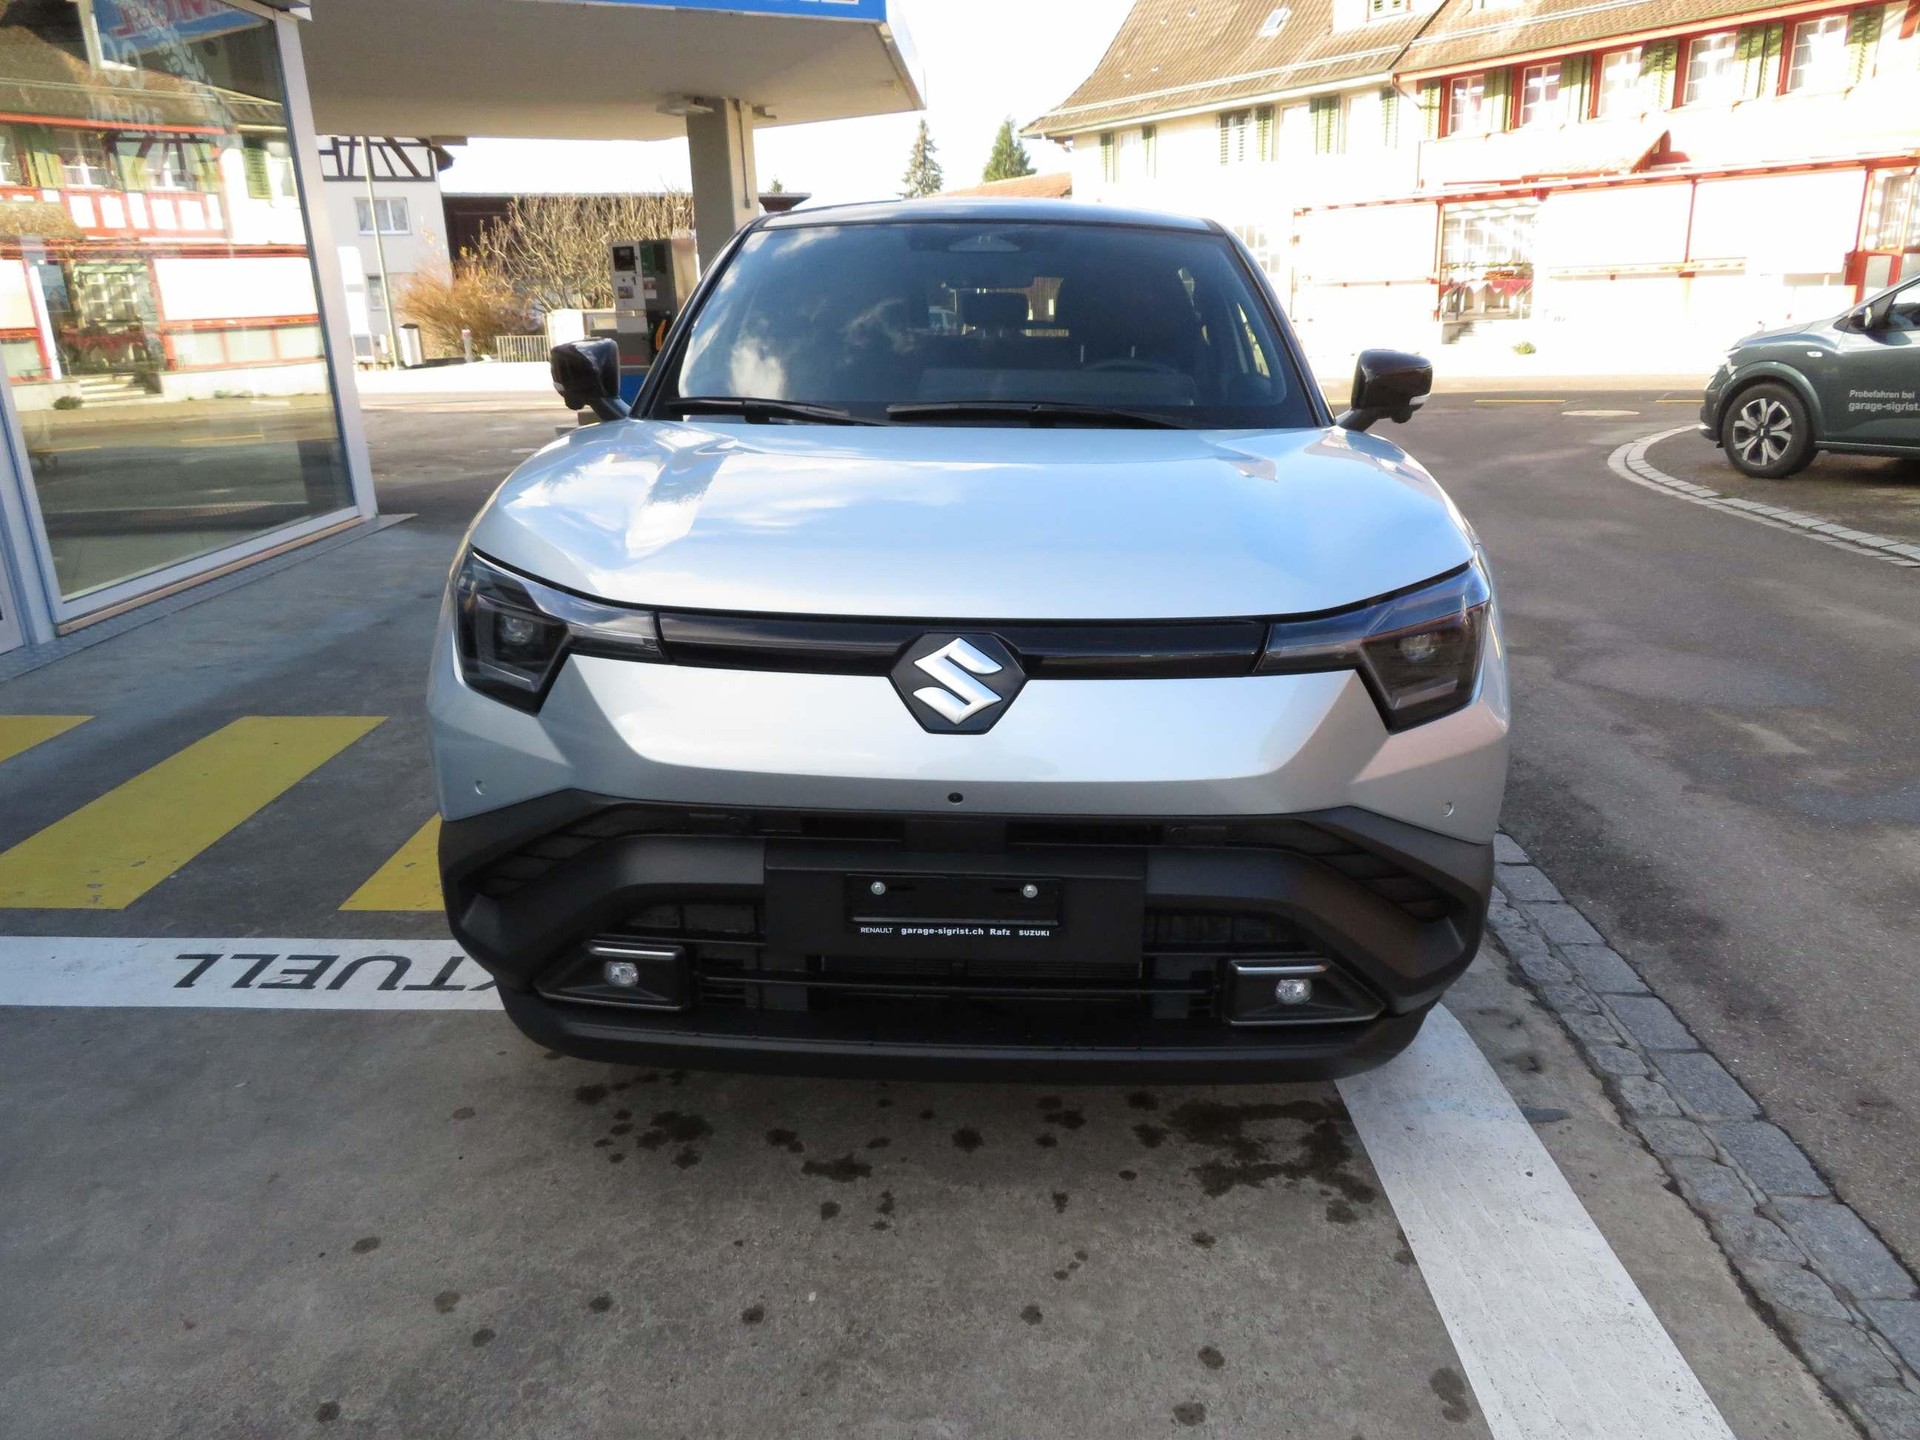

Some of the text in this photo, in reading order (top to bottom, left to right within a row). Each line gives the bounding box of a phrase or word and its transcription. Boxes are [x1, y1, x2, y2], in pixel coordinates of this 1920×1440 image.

[1849, 389, 1915, 399] Probefahren bei
[860, 926, 1050, 937] RENAULT garage-sigrist.ch Rafz SUZUKI
